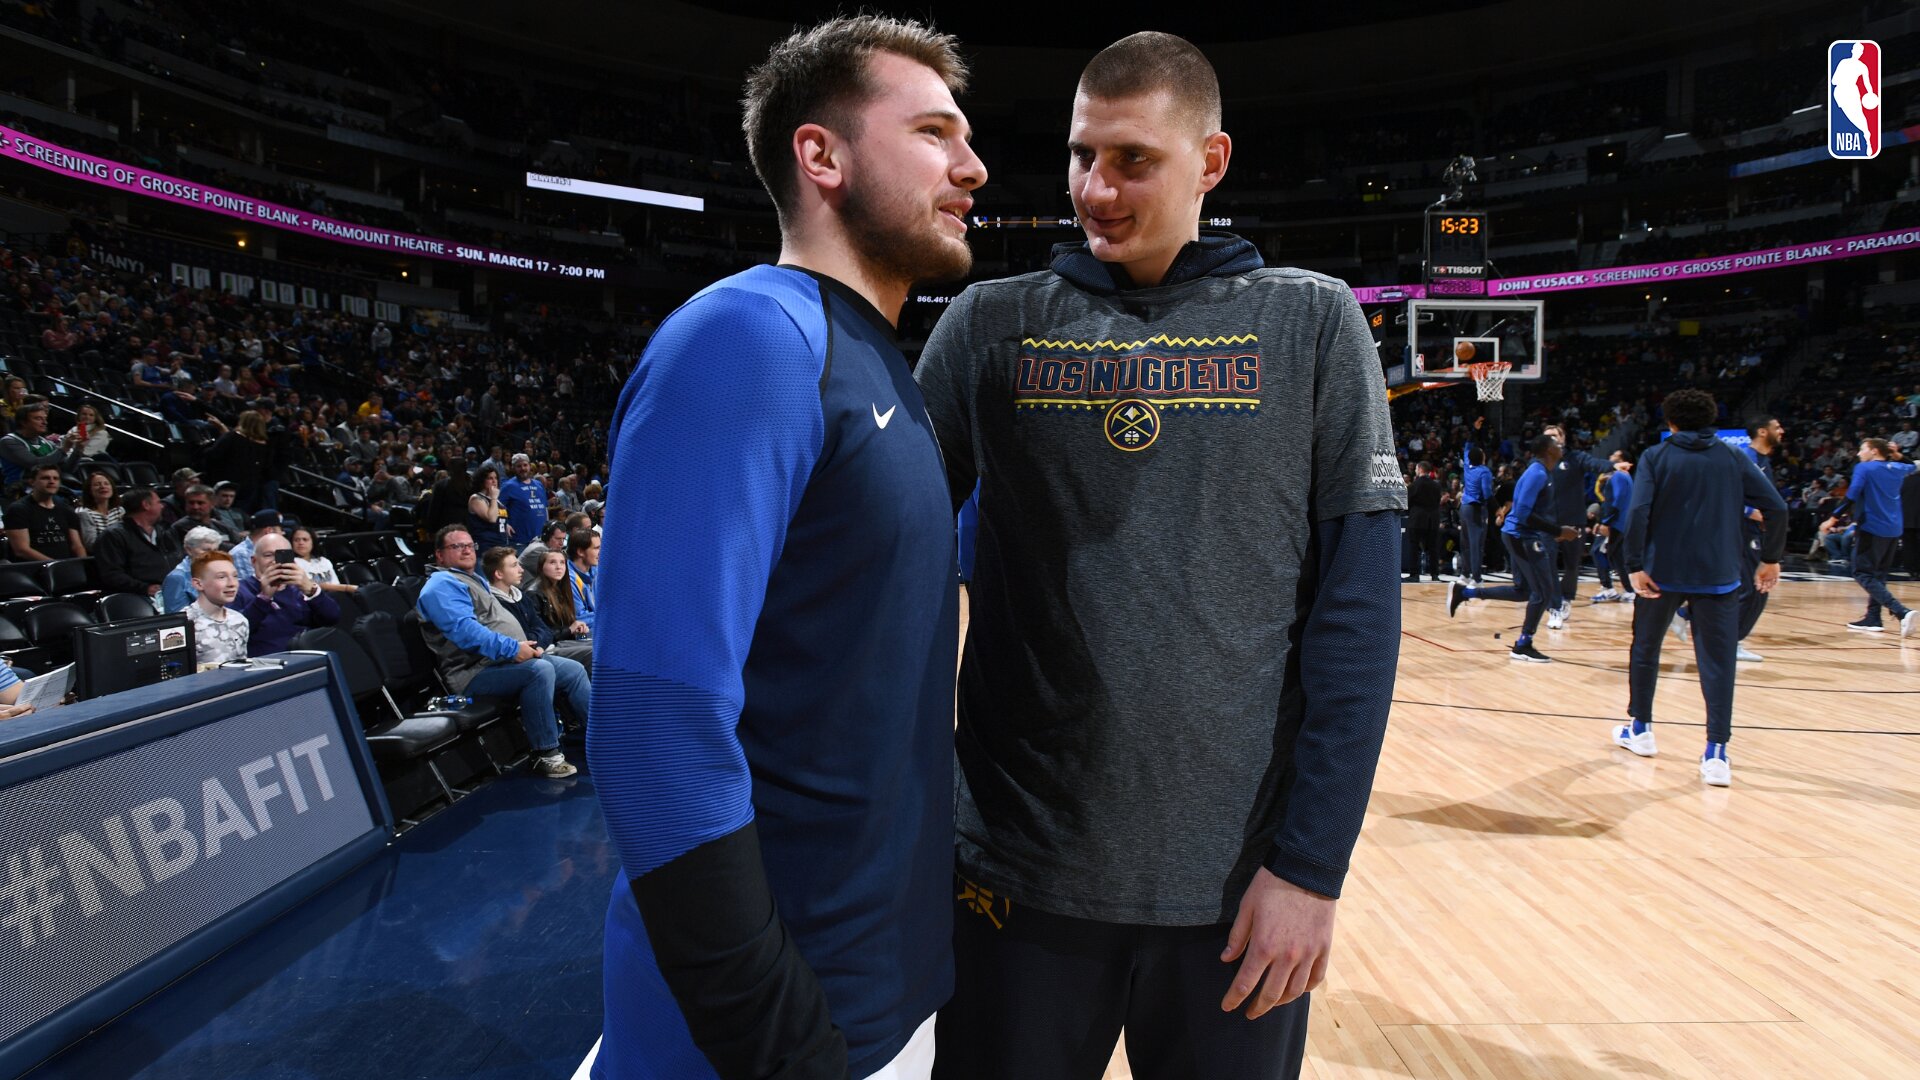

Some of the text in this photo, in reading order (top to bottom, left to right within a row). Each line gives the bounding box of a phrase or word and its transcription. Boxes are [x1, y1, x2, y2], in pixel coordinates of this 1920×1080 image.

[14, 137, 108, 178] SCREENING
[113, 168, 135, 184] OF
[140, 175, 199, 202] GROSSE
[204, 191, 254, 215] POINTE
[257, 205, 300, 226] BLANK
[312, 218, 390, 245] PARAMOUNT
[393, 235, 444, 254] THEATRE
[456, 246, 486, 262] SUN.
[488, 253, 533, 270] MARCH
[536, 261, 549, 272] 17
[559, 264, 583, 277] 7:00
[586, 268, 605, 279] PM
[1209, 217, 1232, 226] 15:23
[1440, 217, 1479, 234] 15:23
[1447, 266, 1484, 274] TISSOT
[1497, 279, 1530, 292] JOHN
[1533, 275, 1589, 291] CUSACK-
[1593, 267, 1660, 284] SCREENING
[1663, 264, 1679, 276] OF
[1682, 258, 1731, 275] GROSSE
[1735, 252, 1782, 268] POINTE
[1786, 244, 1833, 261] BLANK
[1016, 354, 1261, 394] LOS NUGGETS
[0, 733, 335, 948] #NBAFIT
